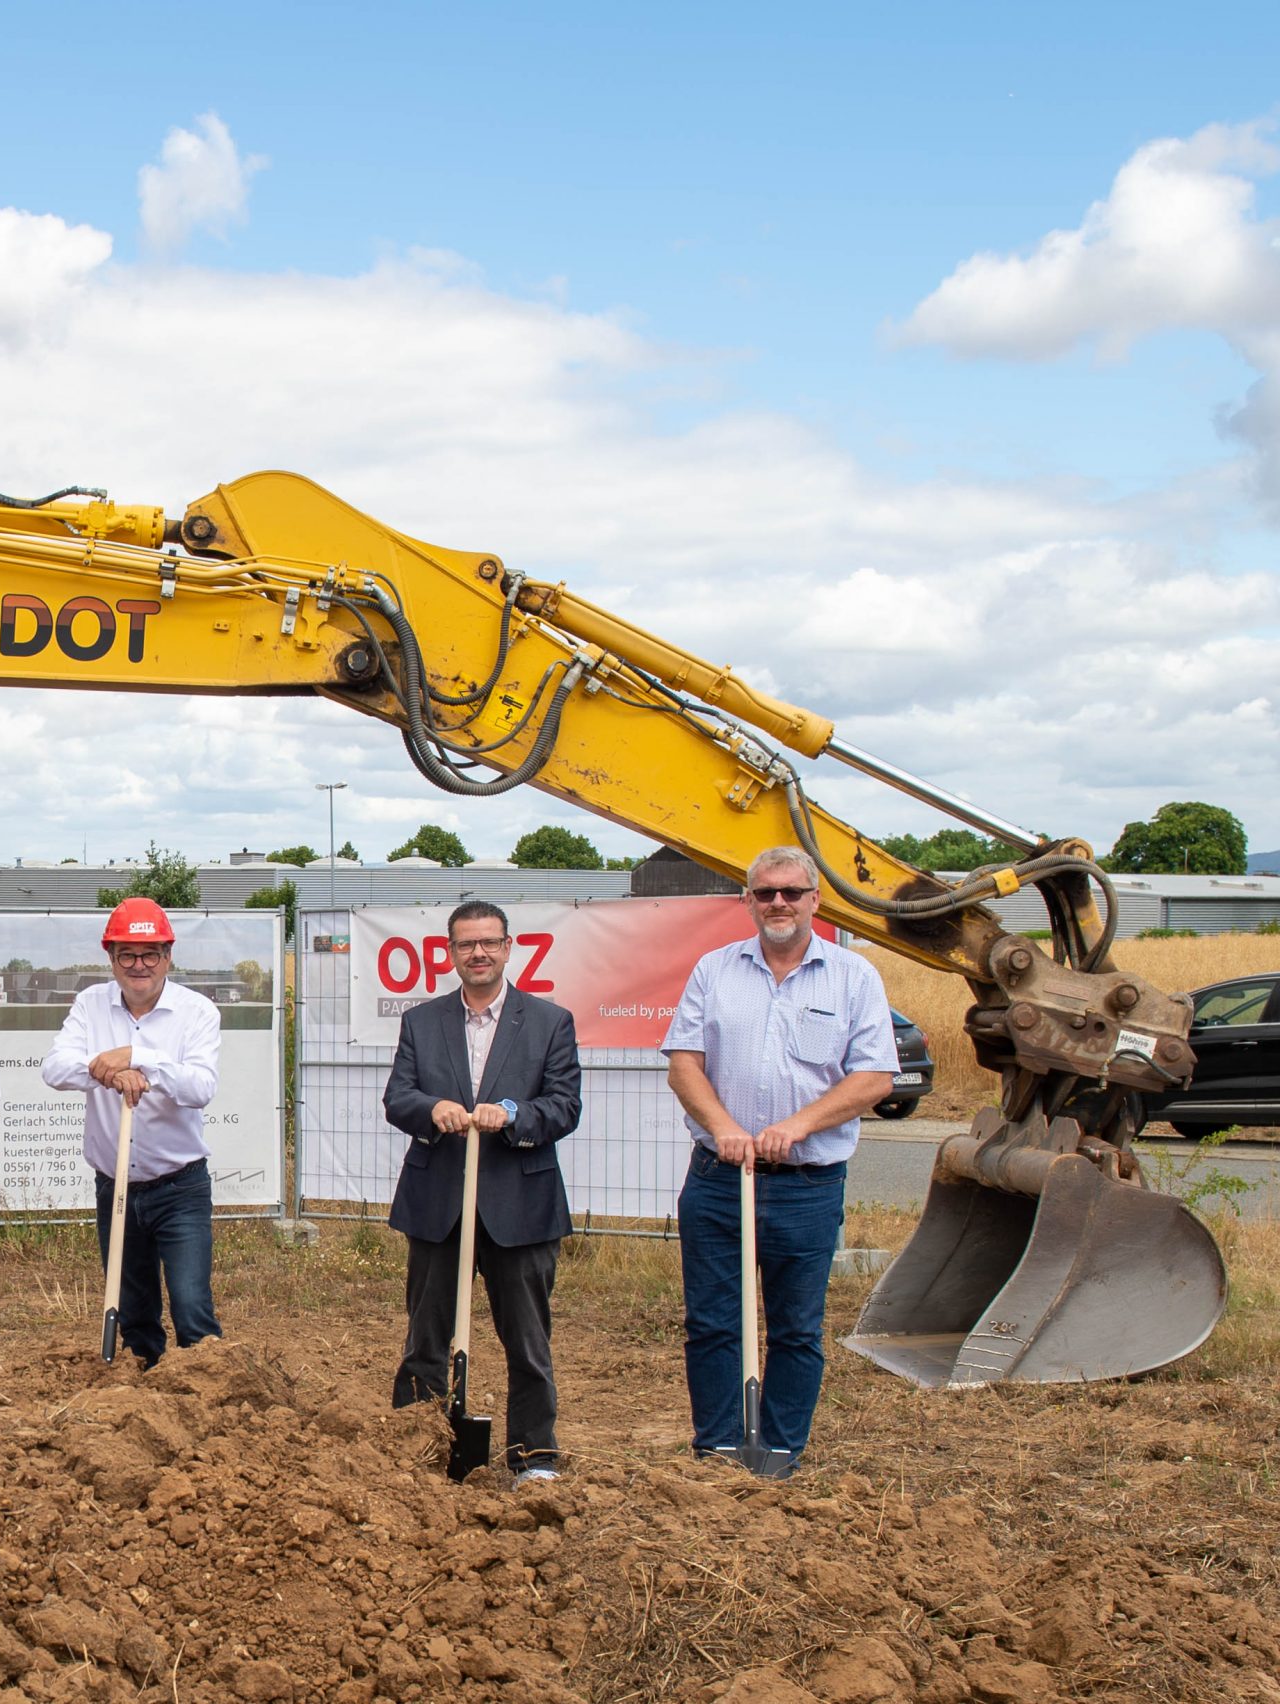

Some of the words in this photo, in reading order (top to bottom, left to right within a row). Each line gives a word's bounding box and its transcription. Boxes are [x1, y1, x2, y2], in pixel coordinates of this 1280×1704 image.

[129, 922, 155, 931] OPITZ
[378, 933, 554, 994] OPZ
[599, 1004, 636, 1017] fueled
[640, 1004, 654, 1019] by
[658, 1007, 678, 1020] pas
[3, 1116, 46, 1127] Gerlach
[223, 1113, 239, 1124] KG
[3, 1131, 85, 1142] Reinsertumwe
[3, 1146, 84, 1159] kuester@gerla
[3, 1162, 36, 1172] 05561
[47, 1161, 66, 1171] 796
[69, 1161, 76, 1171] 0
[3, 1177, 36, 1187] 05561
[47, 1176, 67, 1186] 796
[70, 1176, 82, 1186] 37
